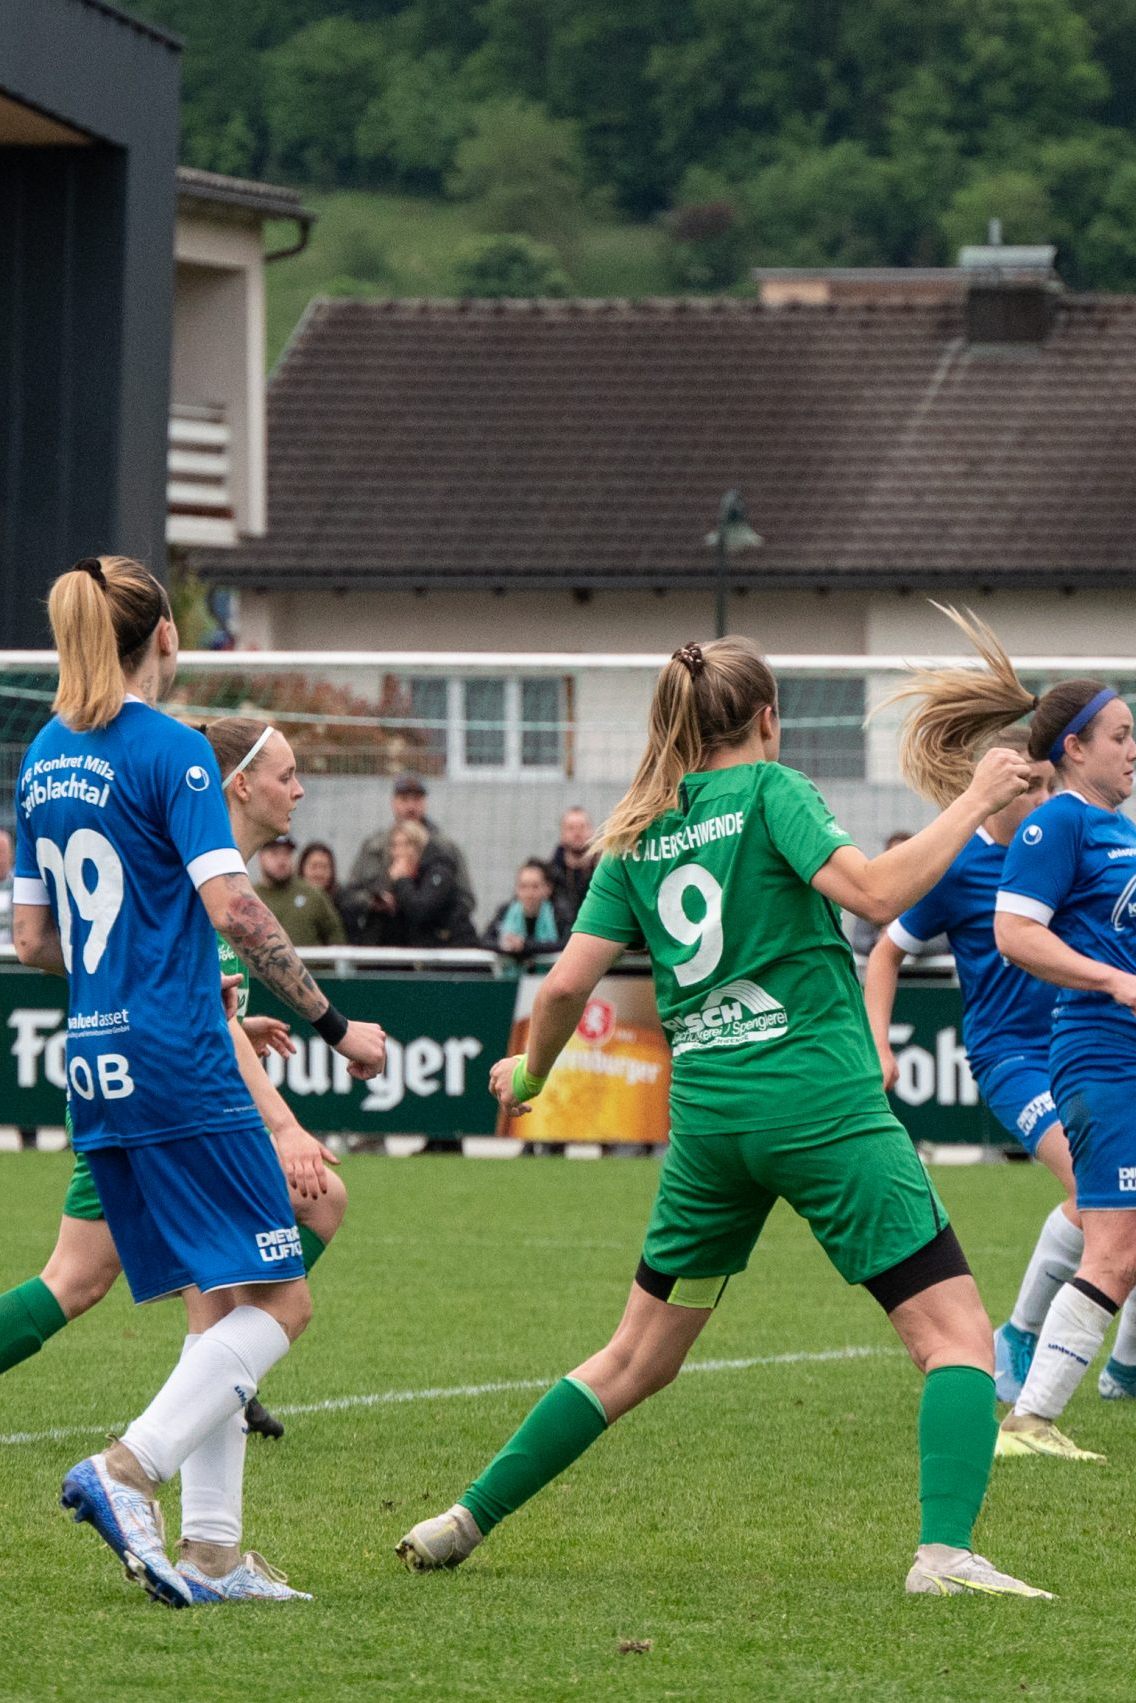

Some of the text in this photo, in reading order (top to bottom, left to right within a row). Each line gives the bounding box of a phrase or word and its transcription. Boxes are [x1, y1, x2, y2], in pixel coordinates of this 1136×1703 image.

[33, 753, 84, 775] Konkret
[84, 755, 116, 781] Milz
[36, 828, 124, 974] 19
[657, 864, 724, 988] 9
[732, 1009, 789, 1036] Spenglerei
